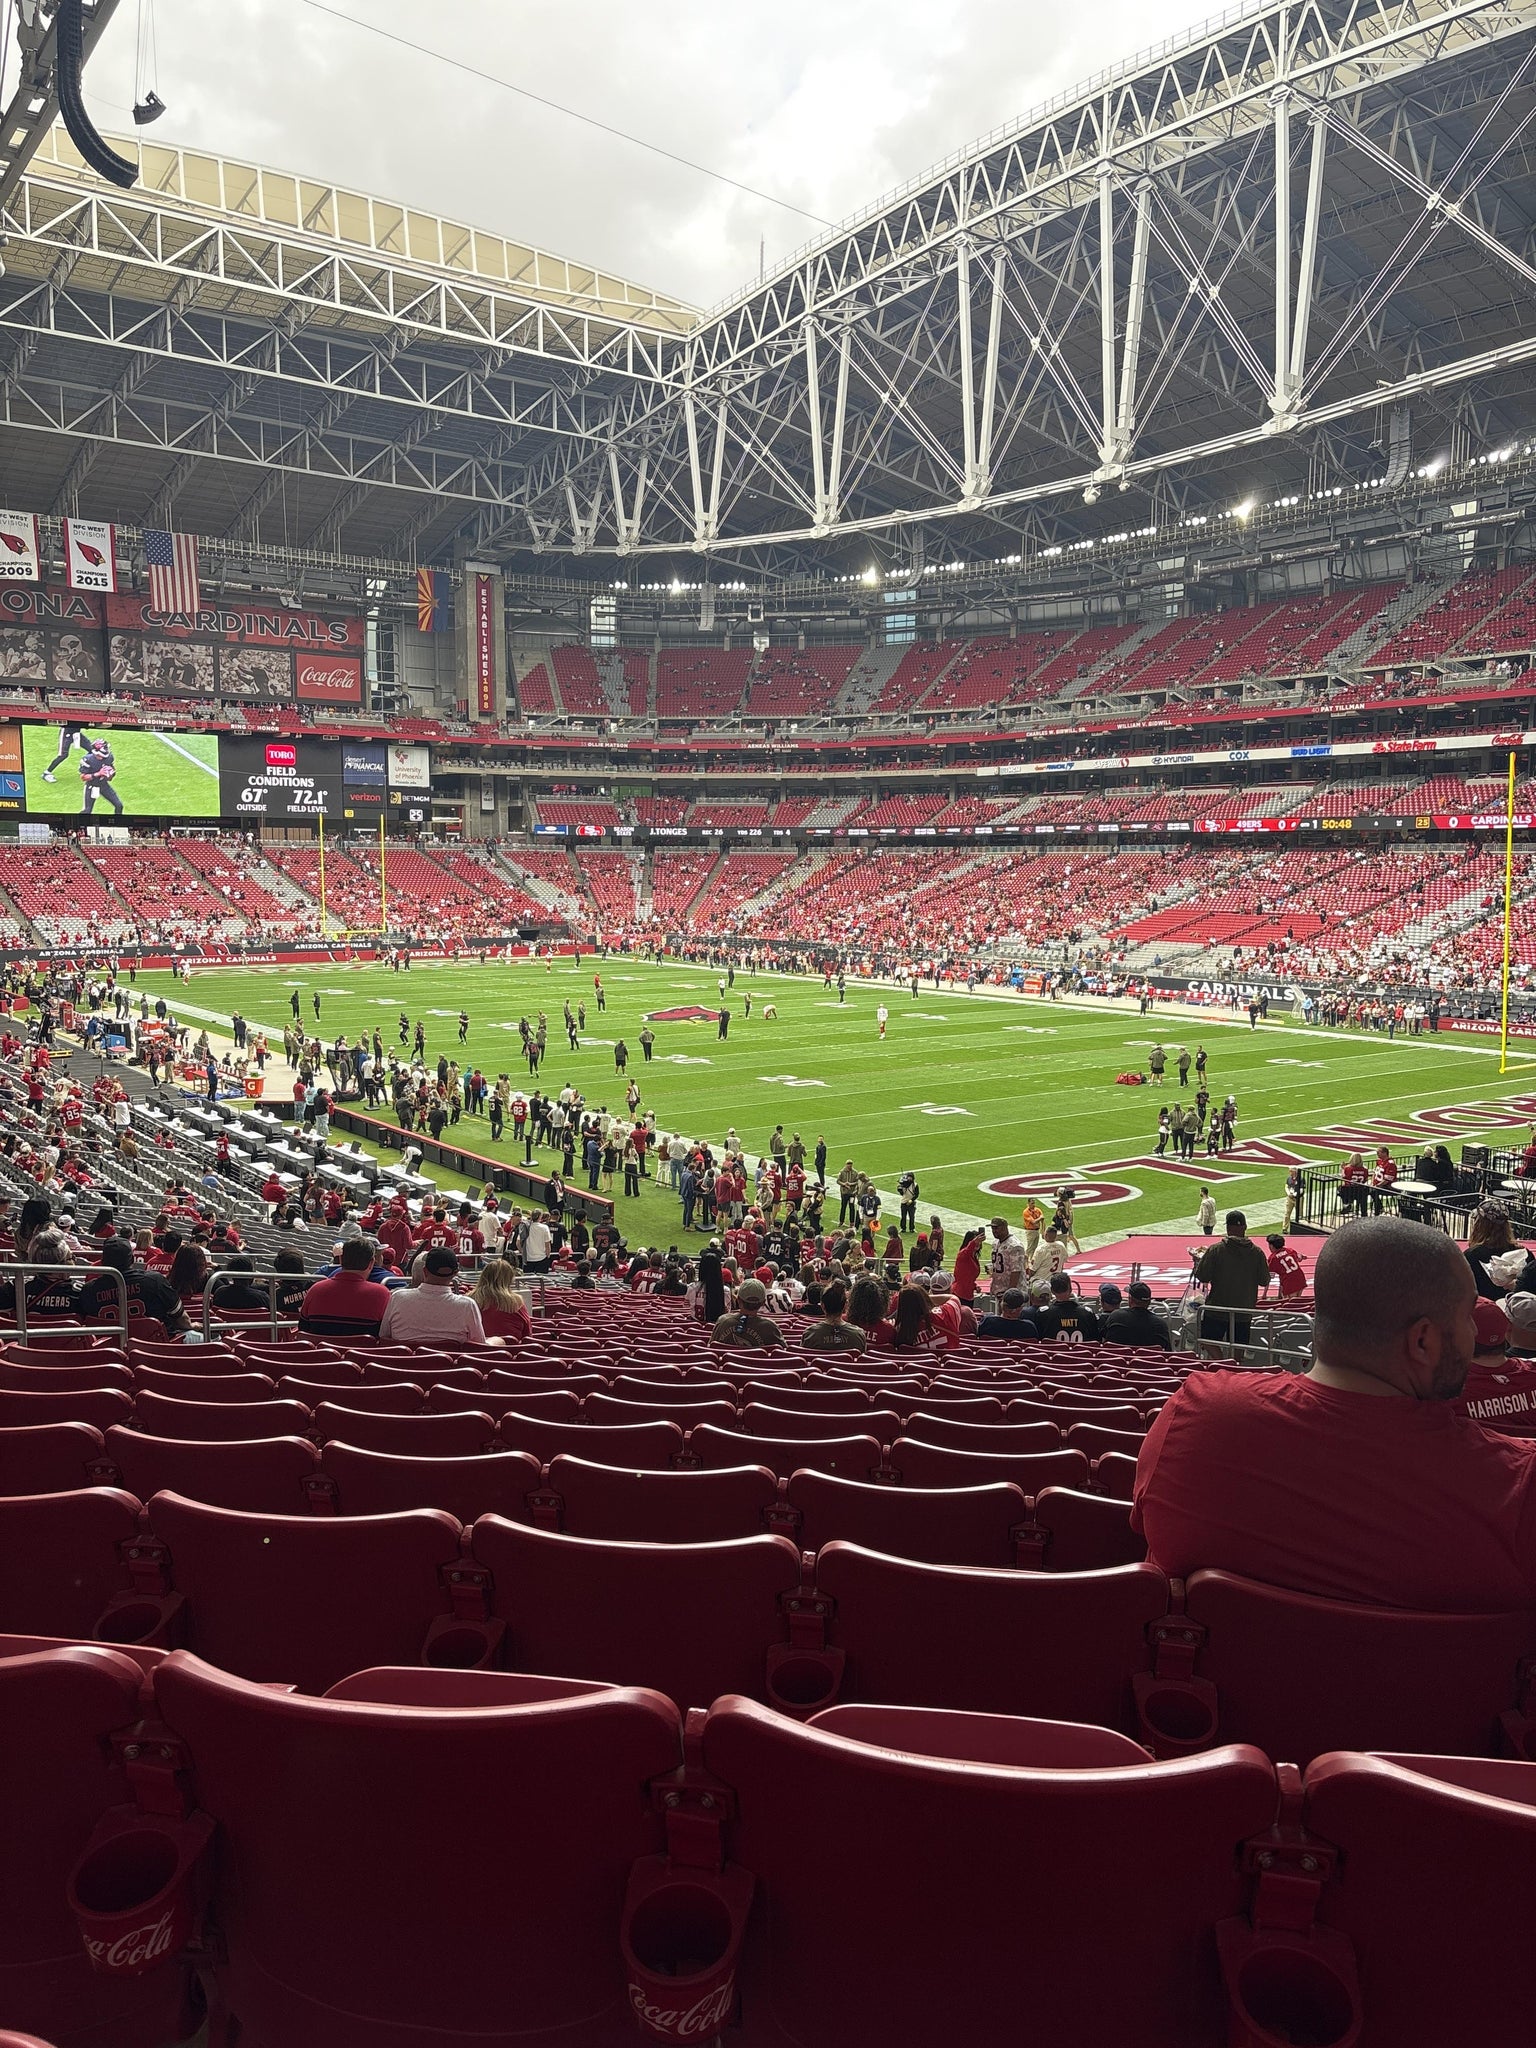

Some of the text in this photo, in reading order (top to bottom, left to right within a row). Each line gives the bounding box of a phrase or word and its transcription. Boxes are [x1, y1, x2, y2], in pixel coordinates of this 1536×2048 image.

[73, 530, 106, 539] DIVISION
[0, 567, 33, 576] 2009
[76, 569, 107, 577] CHAMPIONS
[76, 576, 108, 587] 2015
[140, 604, 349, 644] CARDINALS
[481, 588, 489, 677] ESTABLISHED
[300, 666, 359, 689] Coca-Cola
[1335, 703, 1366, 711] TILLMAN
[106, 716, 177, 726] ARIZONA CARDINALS
[1116, 722, 1141, 730] WILLIAM
[1387, 740, 1437, 752] State Farm
[1229, 751, 1250, 761] COX
[1291, 747, 1332, 756] BUD LIGHT
[1163, 755, 1194, 764] HYUNDAI
[266, 766, 296, 776] FIELD
[394, 766, 422, 775] University
[248, 776, 315, 788] CONDITIONS
[241, 788, 268, 803] 67°
[350, 793, 381, 802] verizon
[402, 795, 430, 803] BETMGM
[236, 803, 267, 812] OUTSIDE
[307, 805, 329, 813] LEVEL
[1236, 819, 1286, 830] 49ERS 0
[1321, 819, 1352, 829] 50:48
[1449, 815, 1532, 828] 0 CARDINALS
[649, 828, 688, 836] J.TONGES
[714, 828, 724, 836] 26
[749, 828, 762, 836] 226
[180, 957, 222, 965] ARIZONA
[1187, 980, 1296, 1001] CARDINALS
[1451, 1021, 1502, 1034] ARIZONA
[66, 1109, 80, 1121] 85
[431, 1237, 446, 1248] 97
[1050, 1258, 1060, 1273] 3
[1280, 1256, 1299, 1274] 13
[641, 1271, 663, 1280] TILLMAN
[1060, 1318, 1078, 1327] WATT
[914, 1325, 941, 1345] ITTLE
[1466, 1393, 1529, 1419] HARRISON
